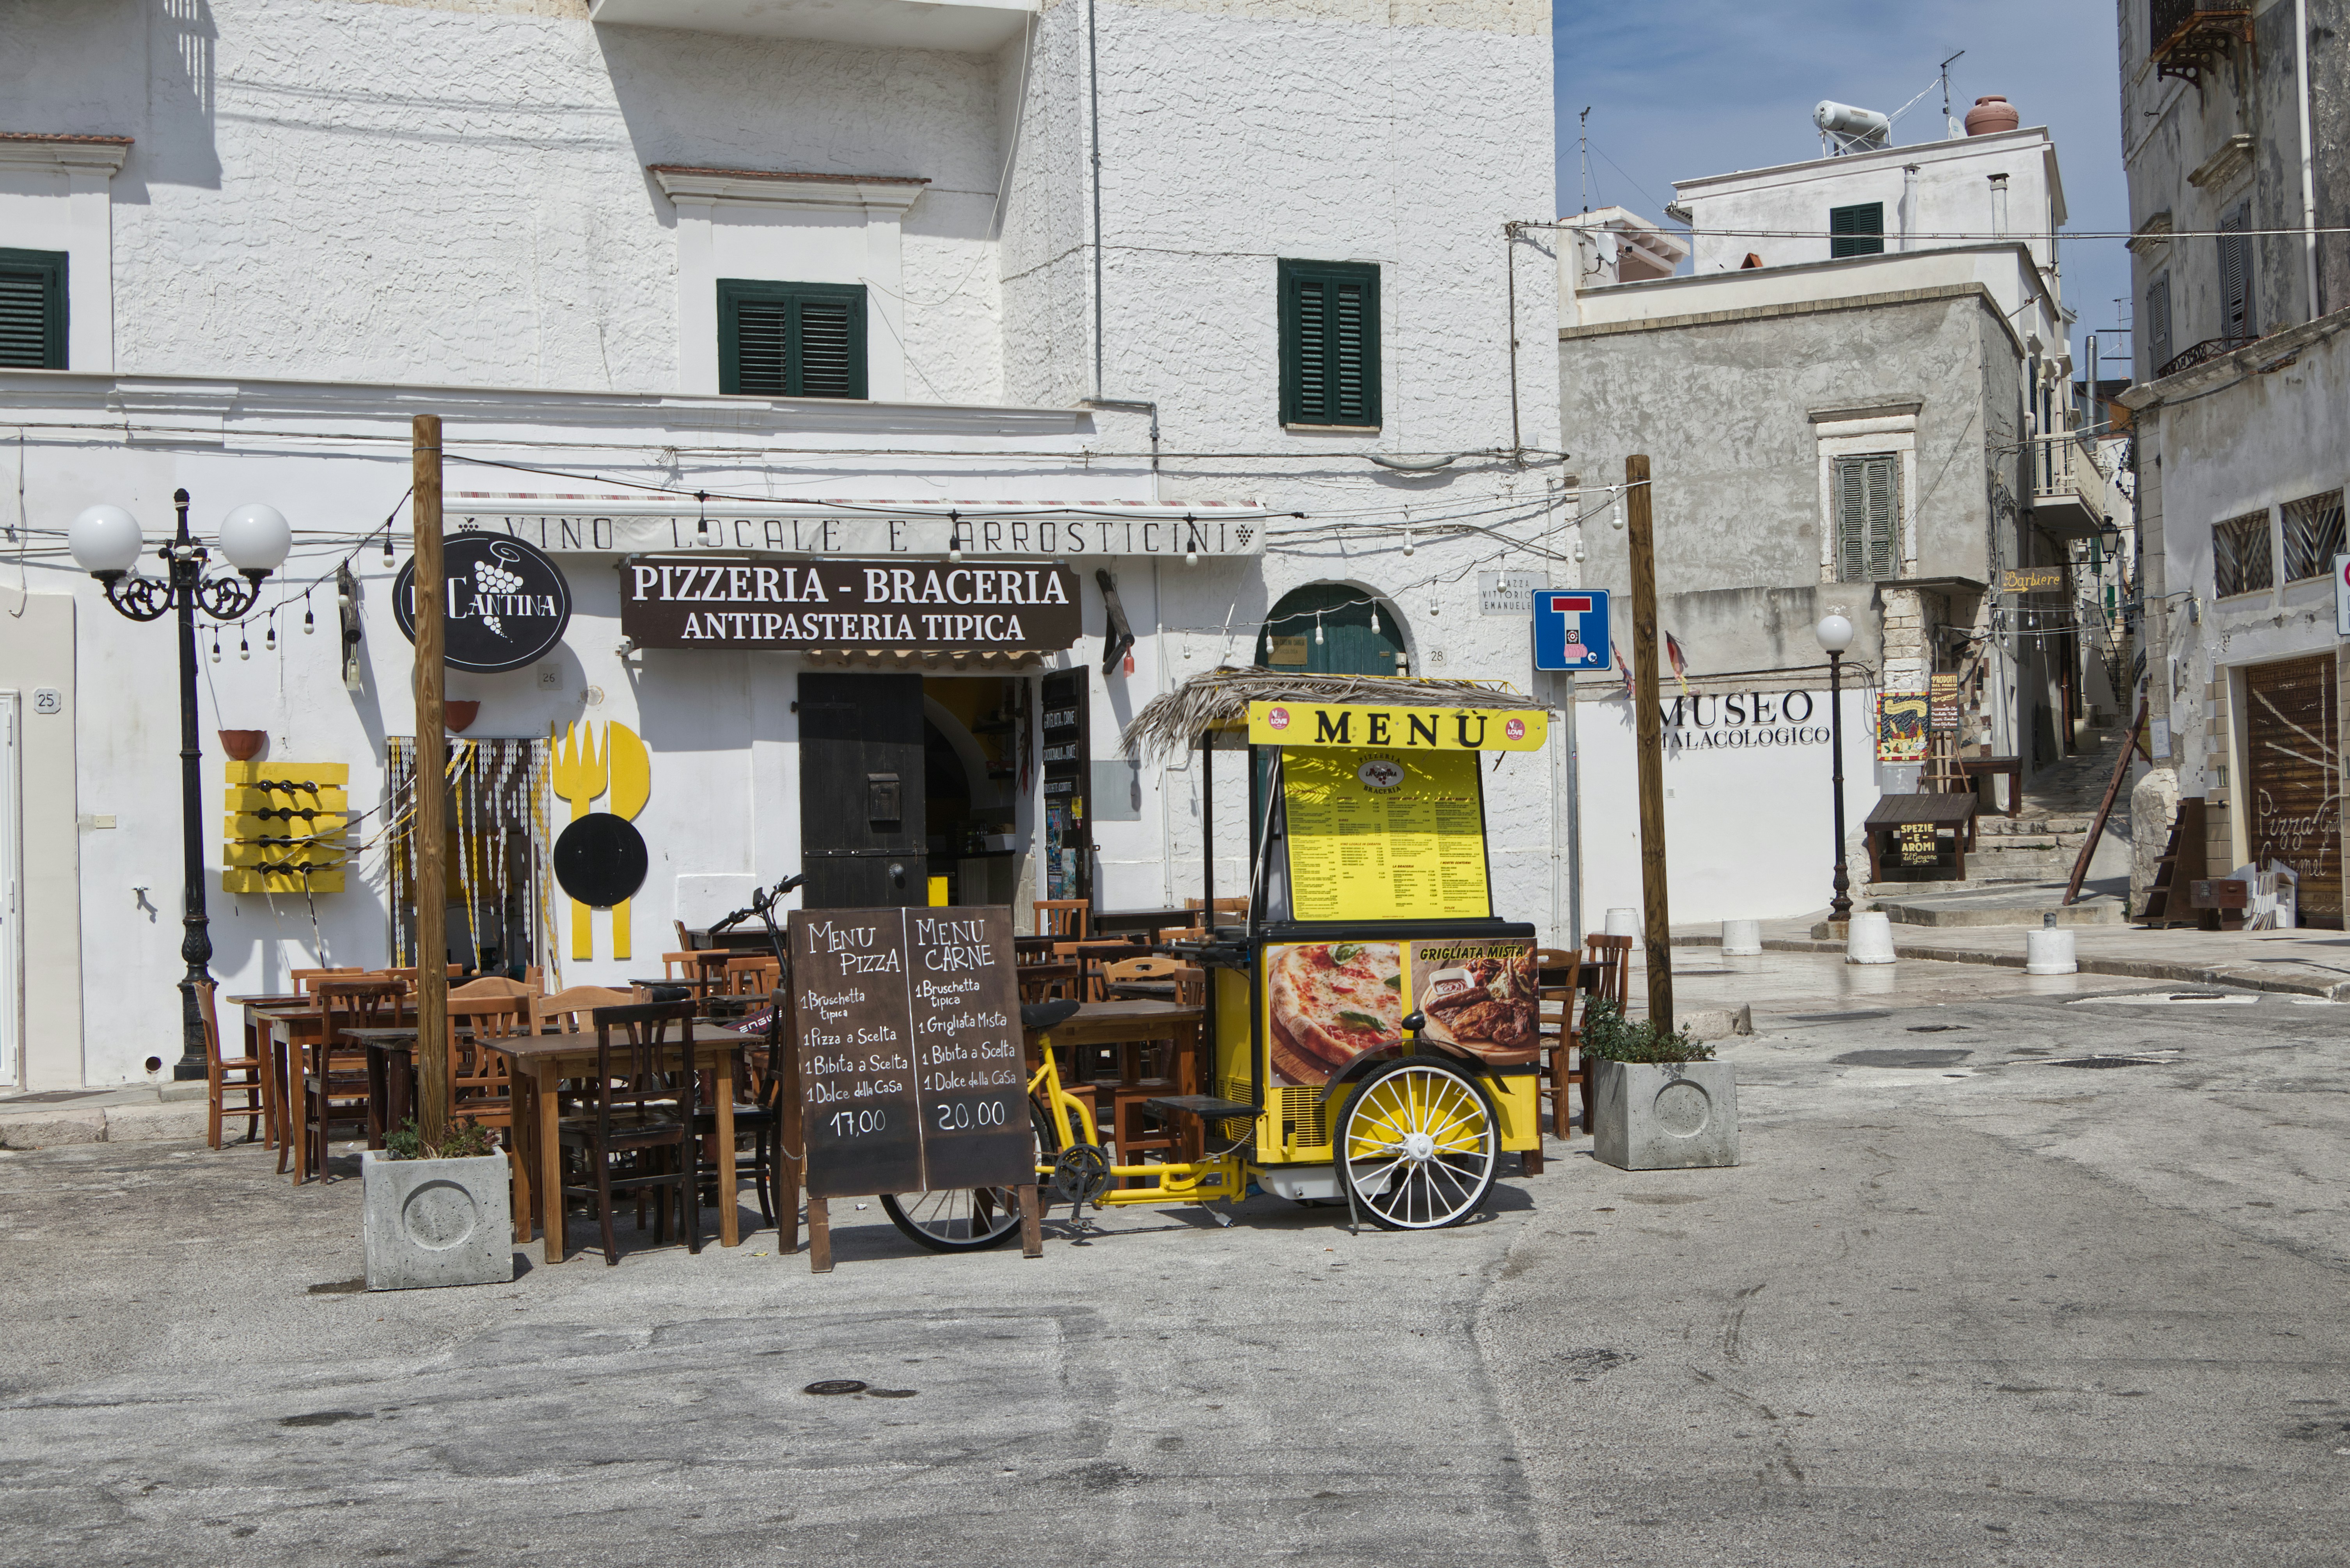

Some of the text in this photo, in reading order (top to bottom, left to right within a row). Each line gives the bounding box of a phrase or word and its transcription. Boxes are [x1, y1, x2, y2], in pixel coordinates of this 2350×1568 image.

[505, 517, 1226, 553] VINO LOCALE E ARROSTICINI
[632, 566, 829, 602] PIZZERIA
[863, 569, 1069, 605] BRACERIA
[2003, 571, 2060, 587] Barbiere
[448, 576, 557, 619] CANTINA
[681, 613, 1026, 642] ANTIPASTERIA TIPICA
[1431, 651, 1443, 662] 28
[543, 673, 555, 683] 26
[38, 694, 54, 707] 25
[1931, 693, 1957, 702] Gargano
[1660, 690, 1813, 727] MUSEO
[1044, 711, 1074, 729] GRIGLIATA CARNE
[1315, 710, 1488, 748] MENÙ
[1358, 753, 1400, 763] PIZZERIA
[1363, 785, 1401, 794] BRACERIA
[1901, 824, 1934, 833] SPEZIE
[2258, 788, 2315, 850] Pizza
[1902, 842, 1935, 852] AROMI
[1912, 852, 1937, 864] Gargano
[808, 921, 876, 954] MENU
[916, 918, 985, 946] MENU
[841, 949, 900, 975] PIZZA
[925, 944, 995, 972] CARNE
[1420, 945, 1525, 961] GRIGLIATA MISTA
[916, 978, 980, 998] 1 Bruschetta
[800, 988, 865, 1011] 1 Bruschetta
[931, 995, 960, 1011] tipica
[820, 1006, 848, 1024] tipica
[919, 1011, 1007, 1036] 1 Grigliata Mista
[804, 1026, 897, 1047] 1 Pizza a Scelta
[922, 1039, 1015, 1065] 1 Bibita a Scelta
[805, 1054, 908, 1075] 1 Bibita a Scelta
[806, 1088, 814, 1102] 1
[816, 1081, 850, 1103] Dolce
[854, 1080, 873, 1098] della
[924, 1075, 932, 1091] 1
[935, 1071, 966, 1091] Dolce
[968, 1071, 989, 1088] della
[830, 1109, 886, 1137] 17,00
[937, 1101, 1005, 1130] 20,00
